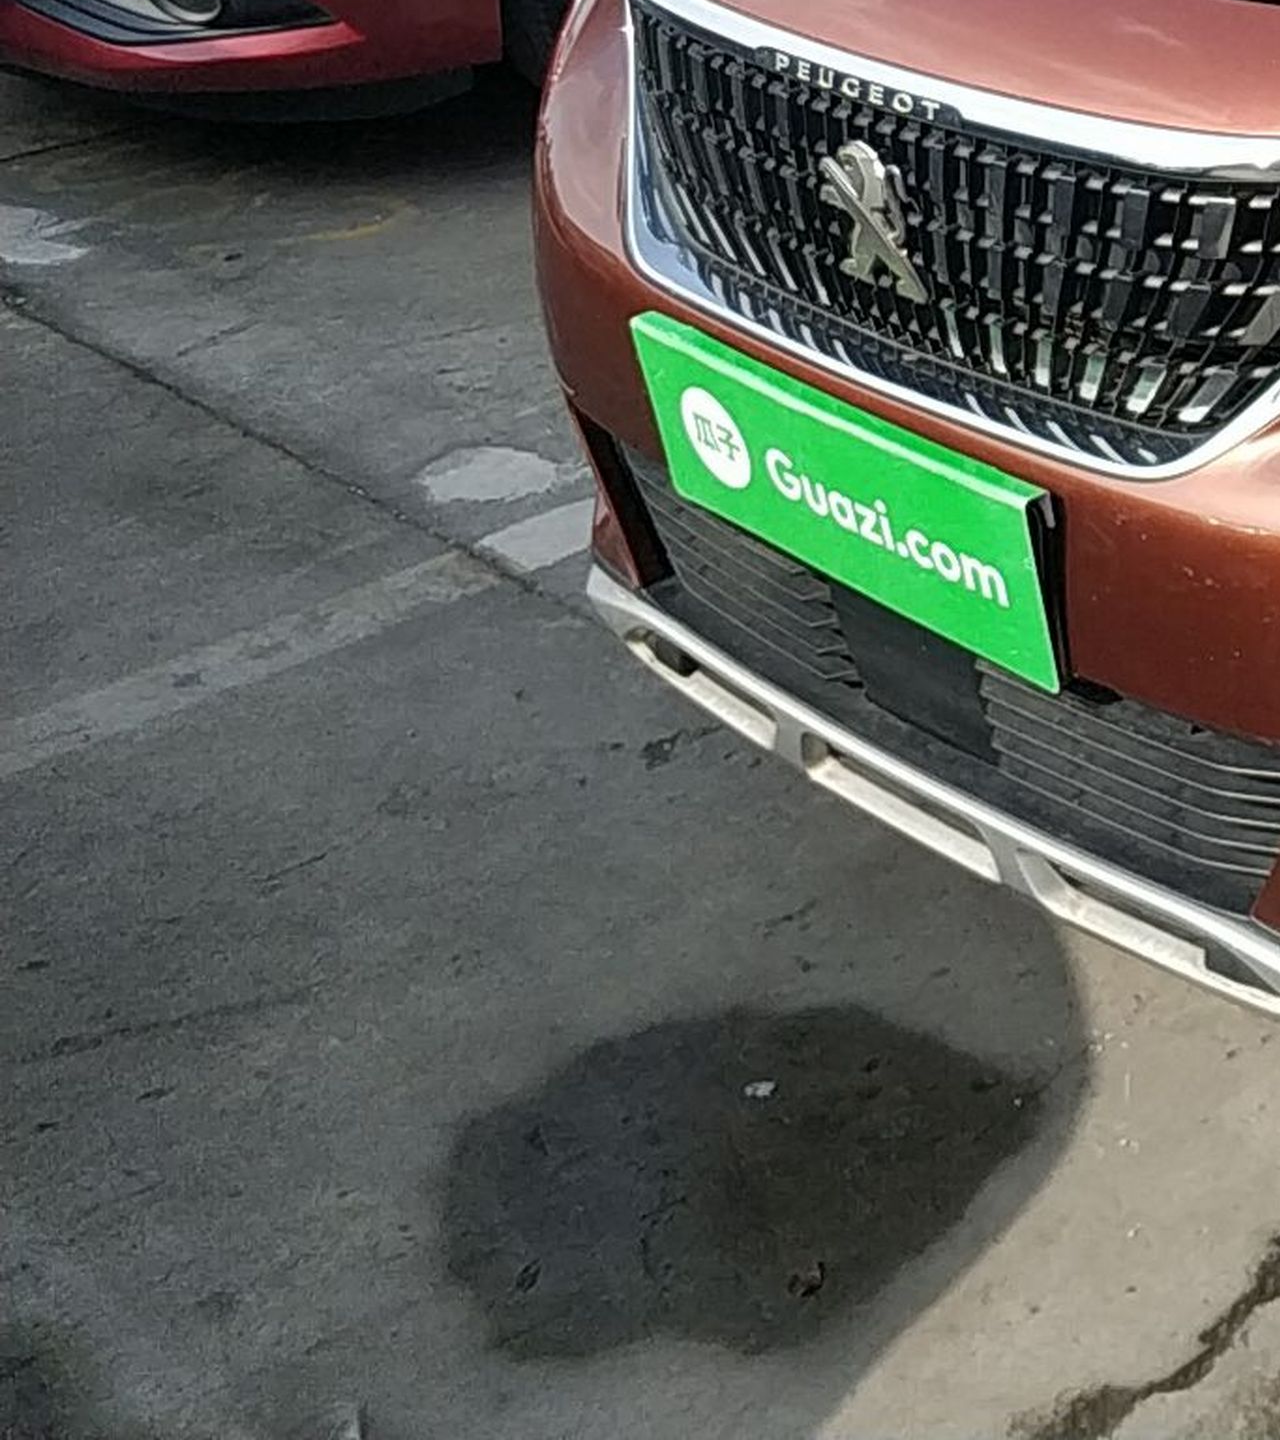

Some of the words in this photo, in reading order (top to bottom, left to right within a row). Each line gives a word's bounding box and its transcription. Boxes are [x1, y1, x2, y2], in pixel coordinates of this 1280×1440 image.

[774, 53, 941, 121] PEUGEOT
[692, 412, 741, 461] 瓜子
[765, 448, 1010, 608] Guazi.com
